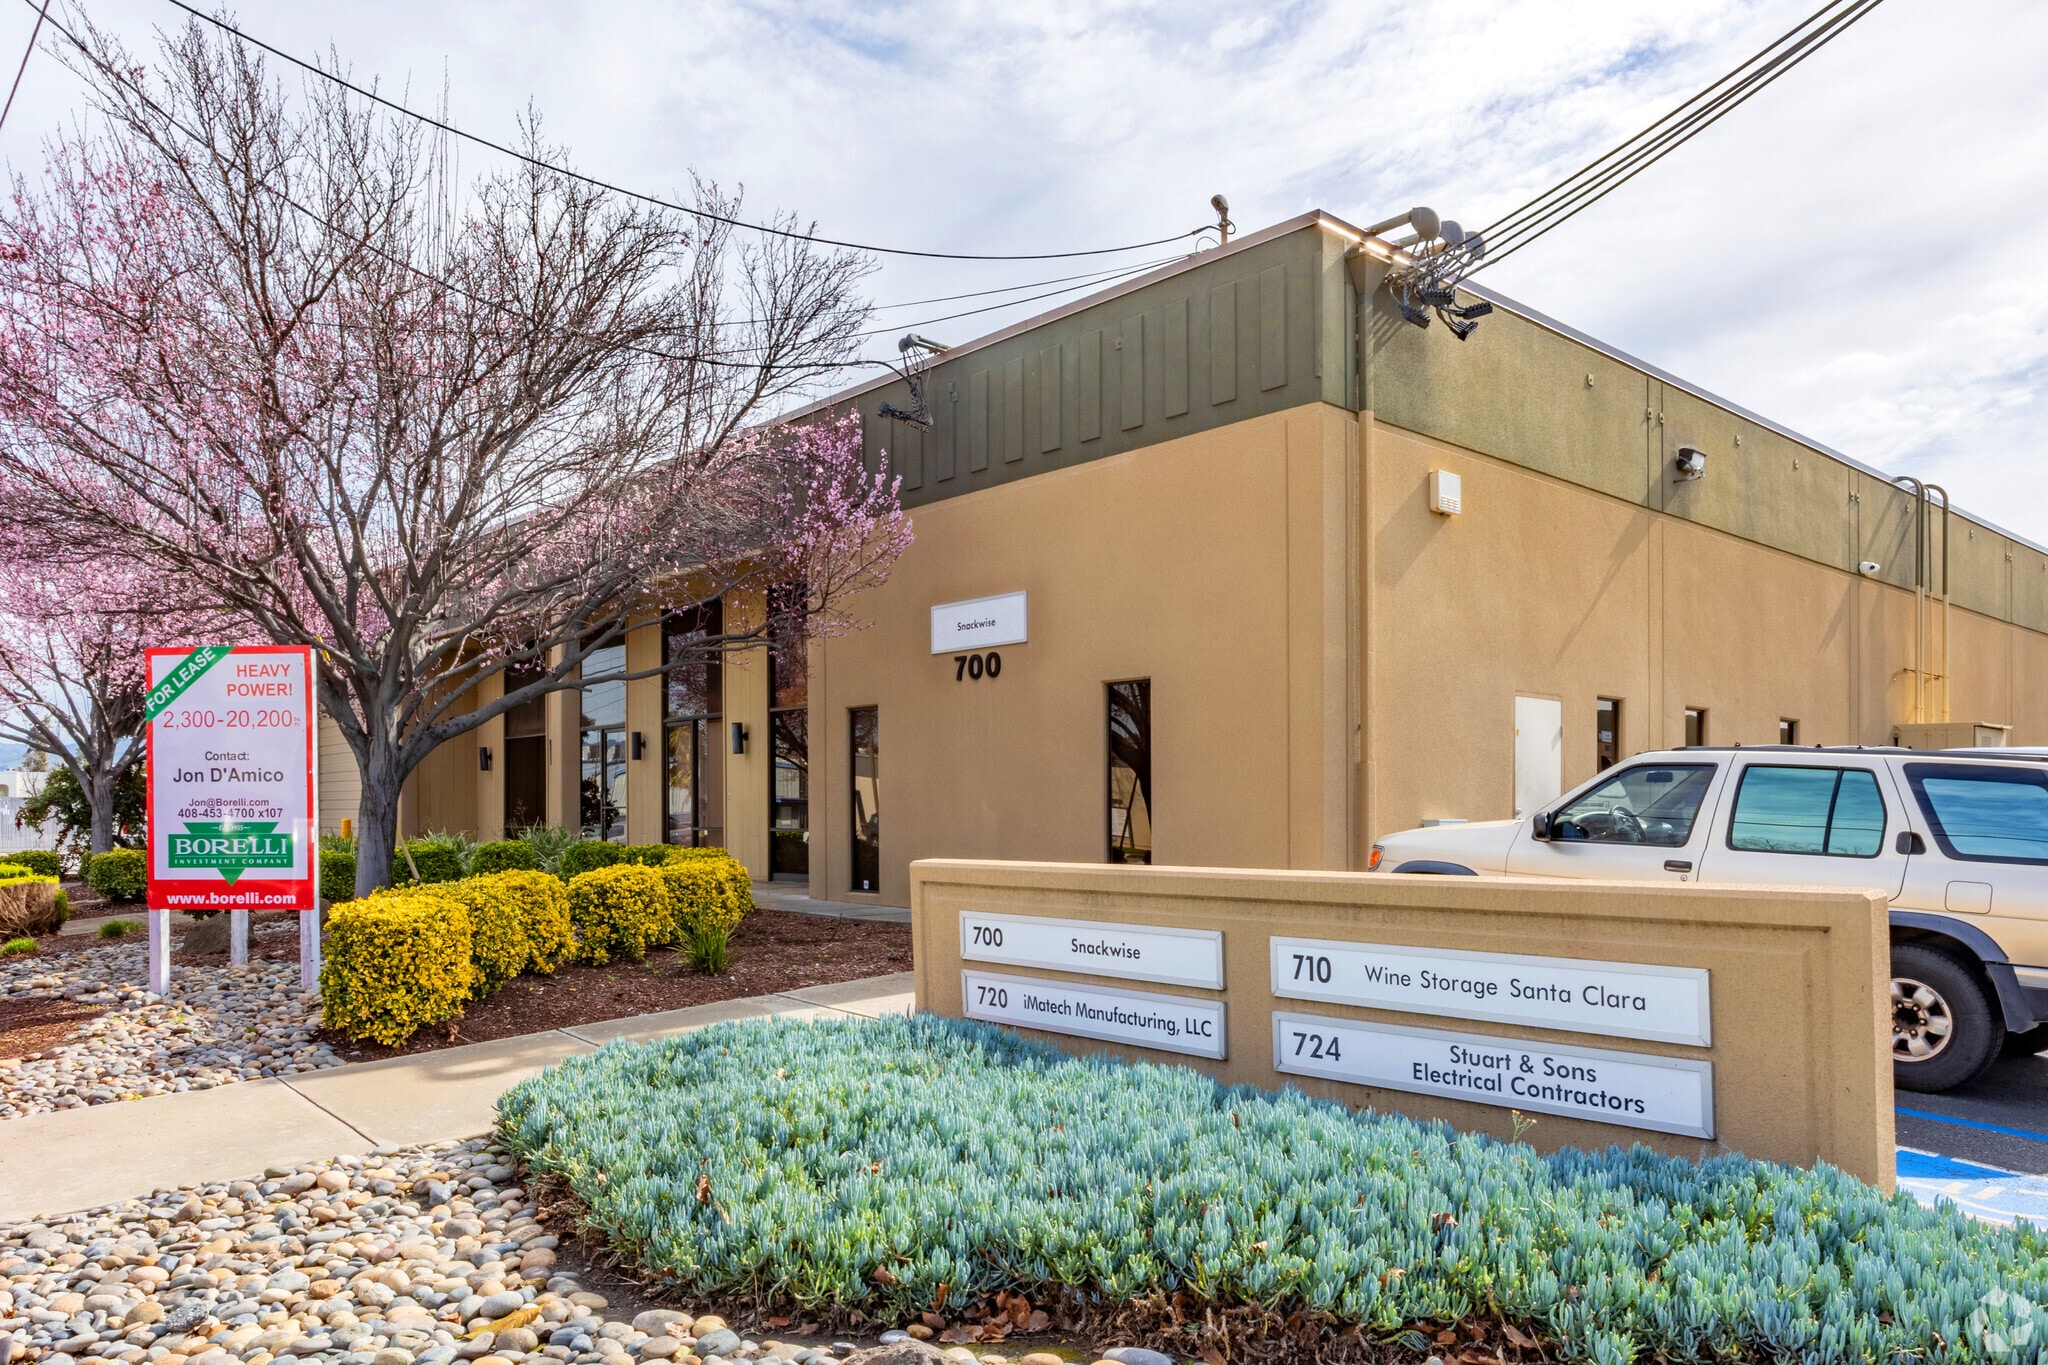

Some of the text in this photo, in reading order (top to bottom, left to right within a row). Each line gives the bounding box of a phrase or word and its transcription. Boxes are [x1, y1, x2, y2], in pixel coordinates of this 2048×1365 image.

[957, 617, 996, 632] Snackwise
[236, 664, 291, 677] HEAVY
[954, 651, 1002, 682] 700
[145, 647, 216, 712] FOR LEASE
[226, 683, 293, 696] POWER!
[163, 710, 293, 730] 2,300-20,200
[204, 751, 250, 761] Contact:
[173, 768, 284, 783] Jon D'Amico
[188, 798, 270, 809] Jon@Borelli.com
[177, 808, 284, 819] 408-453-4700 x107
[174, 838, 288, 855] BORELLI
[166, 892, 297, 905] www.borelli.com
[973, 926, 1141, 960] 700 Snackwise
[1293, 954, 1647, 1011] 710 Wine Storage Santa Clara
[977, 985, 1212, 1038] 720 iMatech Manufacturing, LLC
[1293, 1032, 1597, 1083] 724 Stuart & Sons
[1412, 1062, 1646, 1114] Electrical Contractors
